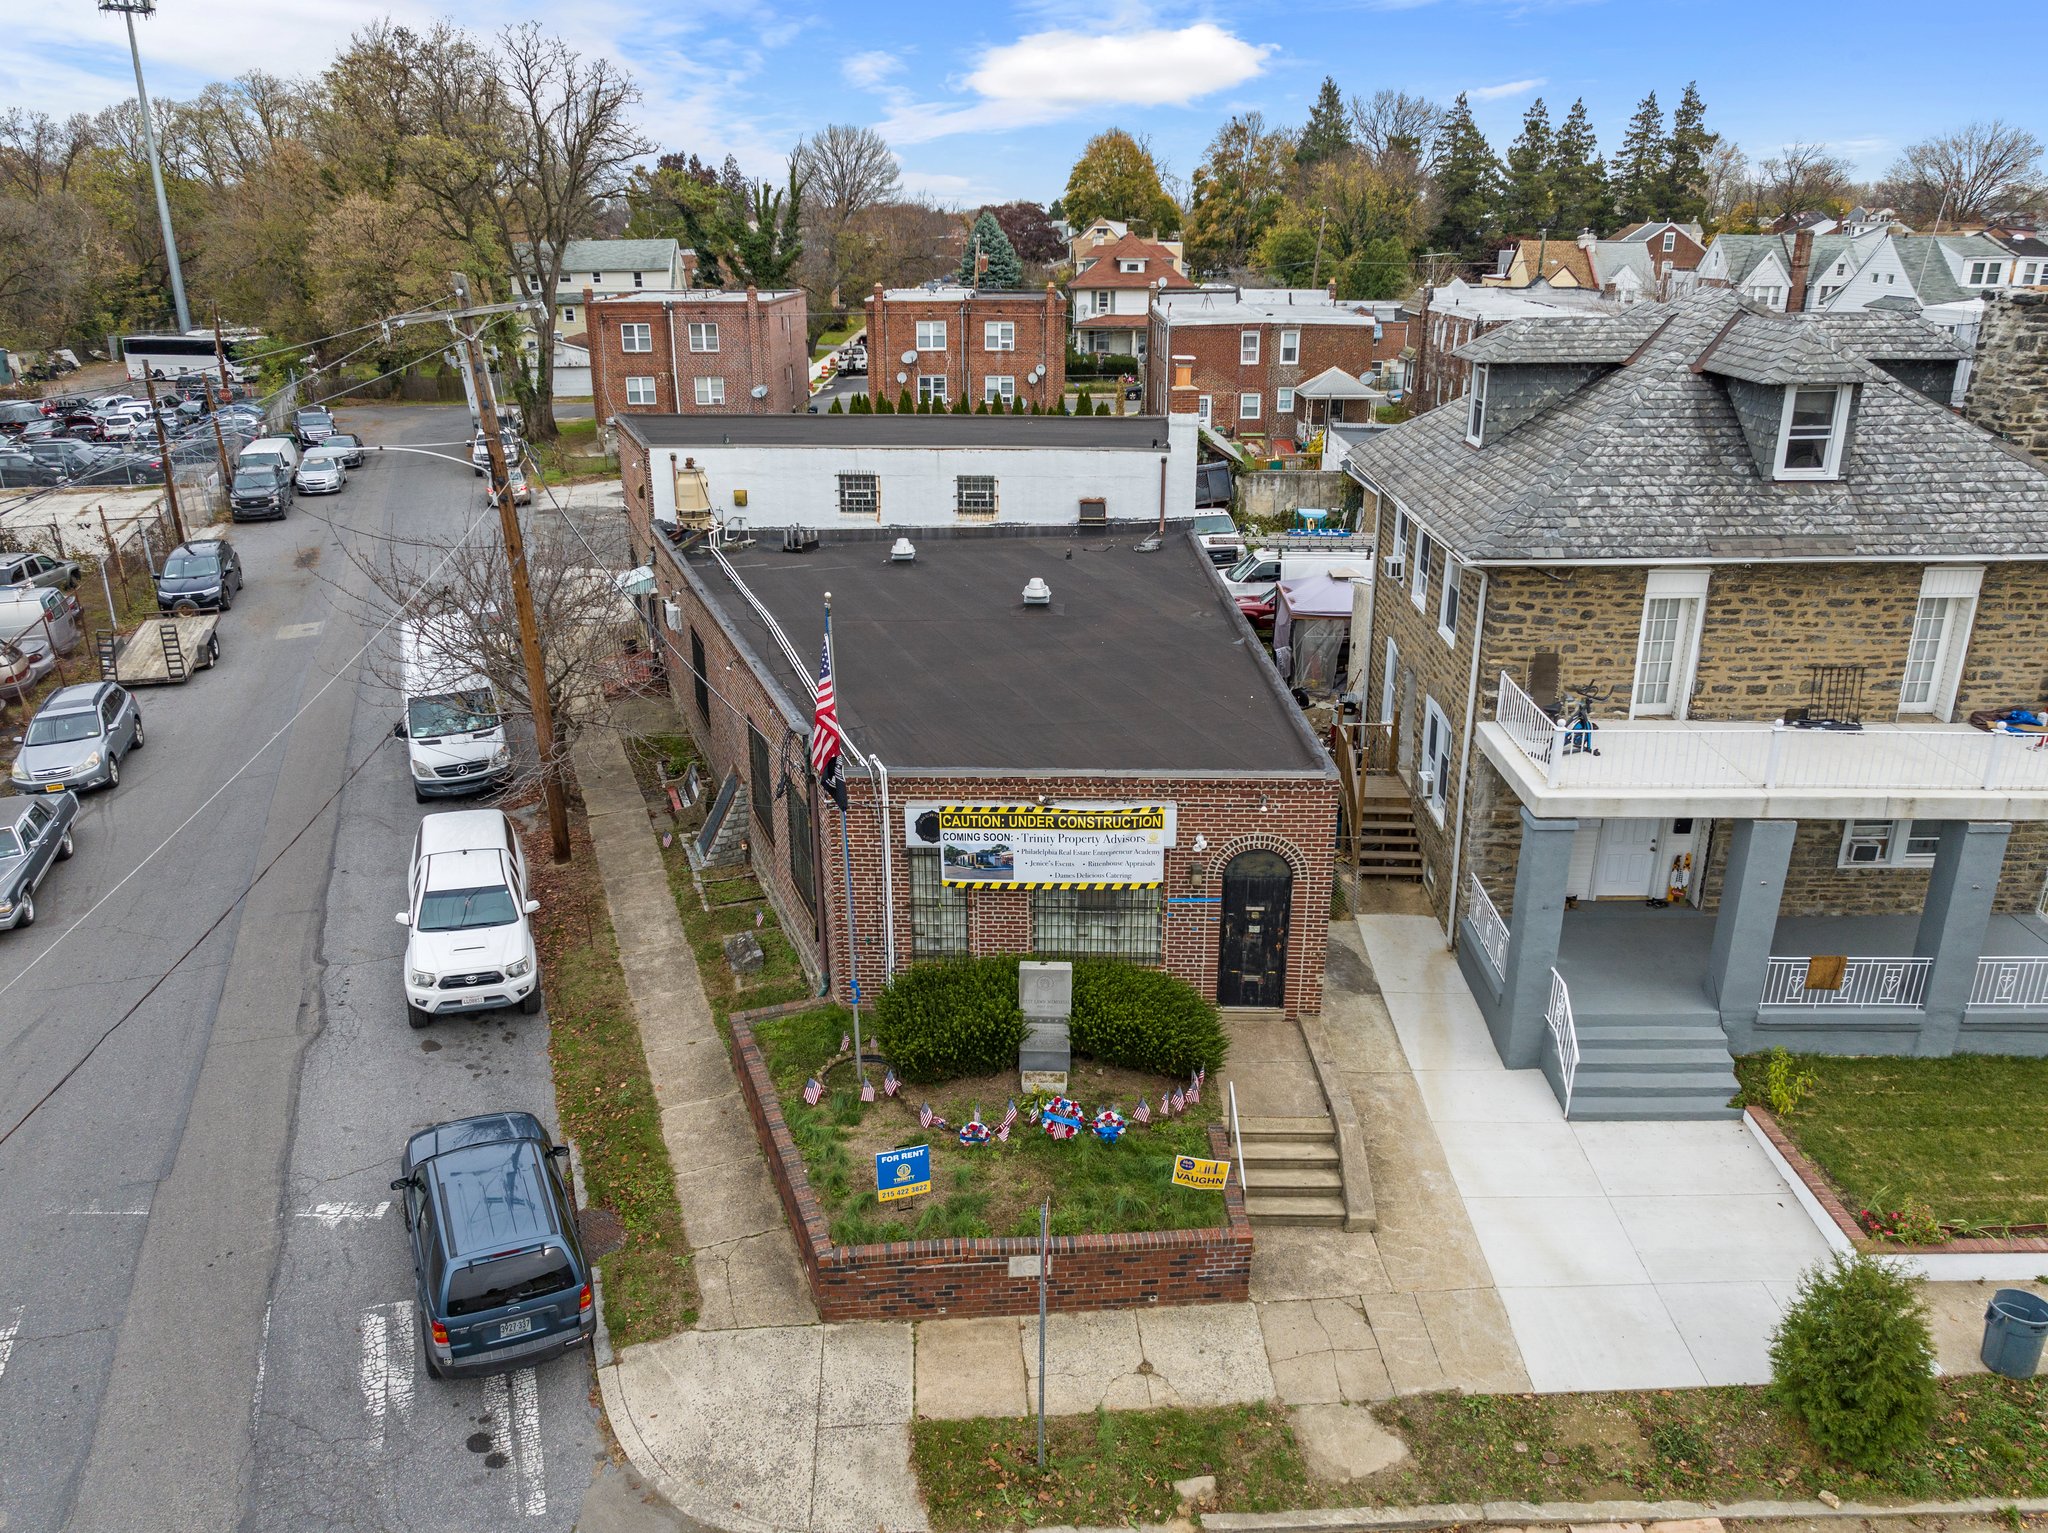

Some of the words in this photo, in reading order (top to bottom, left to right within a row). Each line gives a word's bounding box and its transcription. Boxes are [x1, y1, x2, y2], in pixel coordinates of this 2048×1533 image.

[942, 815, 1005, 828] CAUTION:
[1009, 815, 1055, 828] UNDER
[1058, 815, 1161, 829] CONSTRUCTION
[942, 832, 981, 842] COMING
[983, 832, 1014, 842] SOON:
[1020, 833, 1055, 847] Trinity
[1058, 833, 1100, 847] Property
[1102, 833, 1146, 844] Advisors
[1021, 848, 1058, 857] Philadelphia
[1092, 849, 1133, 857] Entrepreneur
[1134, 848, 1160, 857] Academy
[1125, 860, 1156, 868] Appraisals
[1105, 872, 1132, 880] Catering
[881, 1154, 900, 1164] FOR
[901, 1149, 925, 1160] RENT
[893, 1174, 916, 1184] TRINITY
[1176, 1172, 1225, 1185] VAUGHN
[881, 1191, 895, 1199] 215
[896, 1188, 909, 1196] 422
